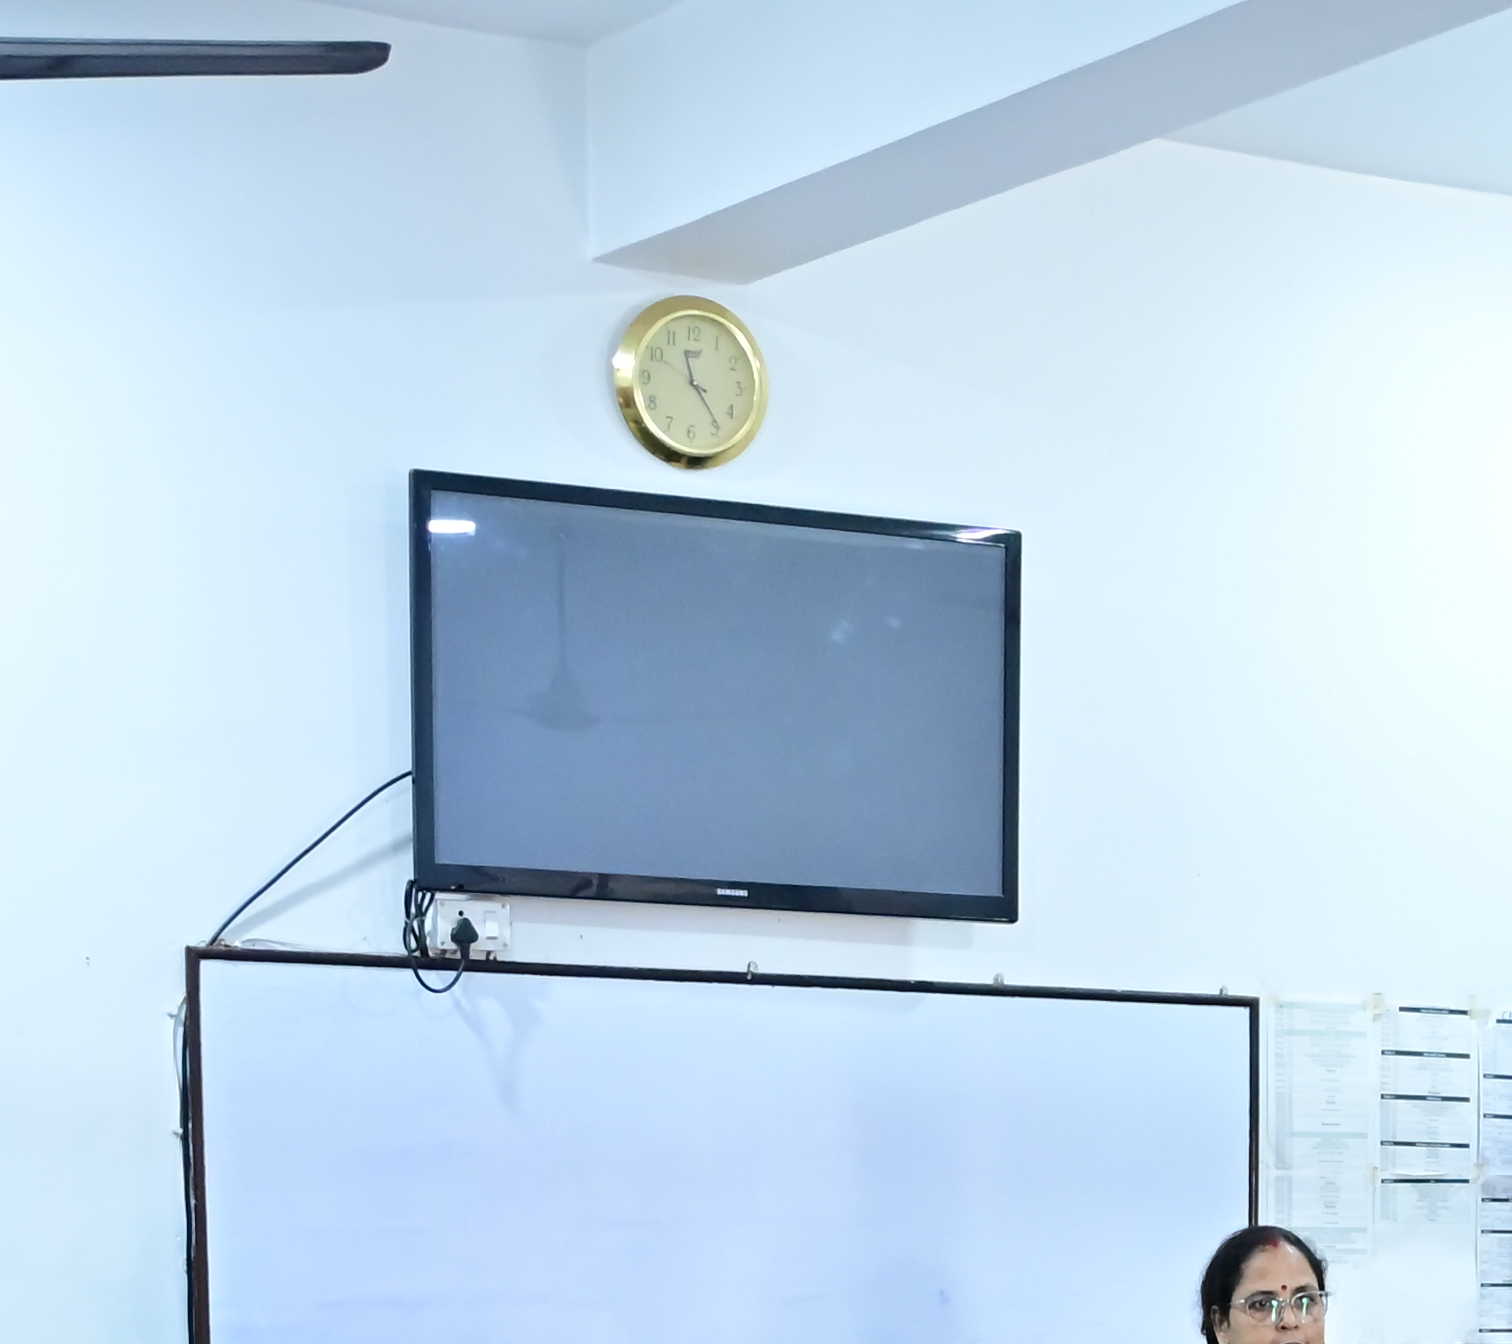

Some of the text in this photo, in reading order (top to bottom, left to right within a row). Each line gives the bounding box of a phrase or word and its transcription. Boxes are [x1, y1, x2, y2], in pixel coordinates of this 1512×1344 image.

[667, 330, 676, 346] 11
[688, 326, 701, 342] 12
[650, 347, 664, 362] 10
[729, 356, 737, 371] 2
[641, 369, 651, 385] 9
[735, 381, 743, 397] 3
[648, 395, 657, 411] 8
[726, 404, 734, 420] 4
[665, 415, 674, 431] 7
[687, 424, 696, 440] 6
